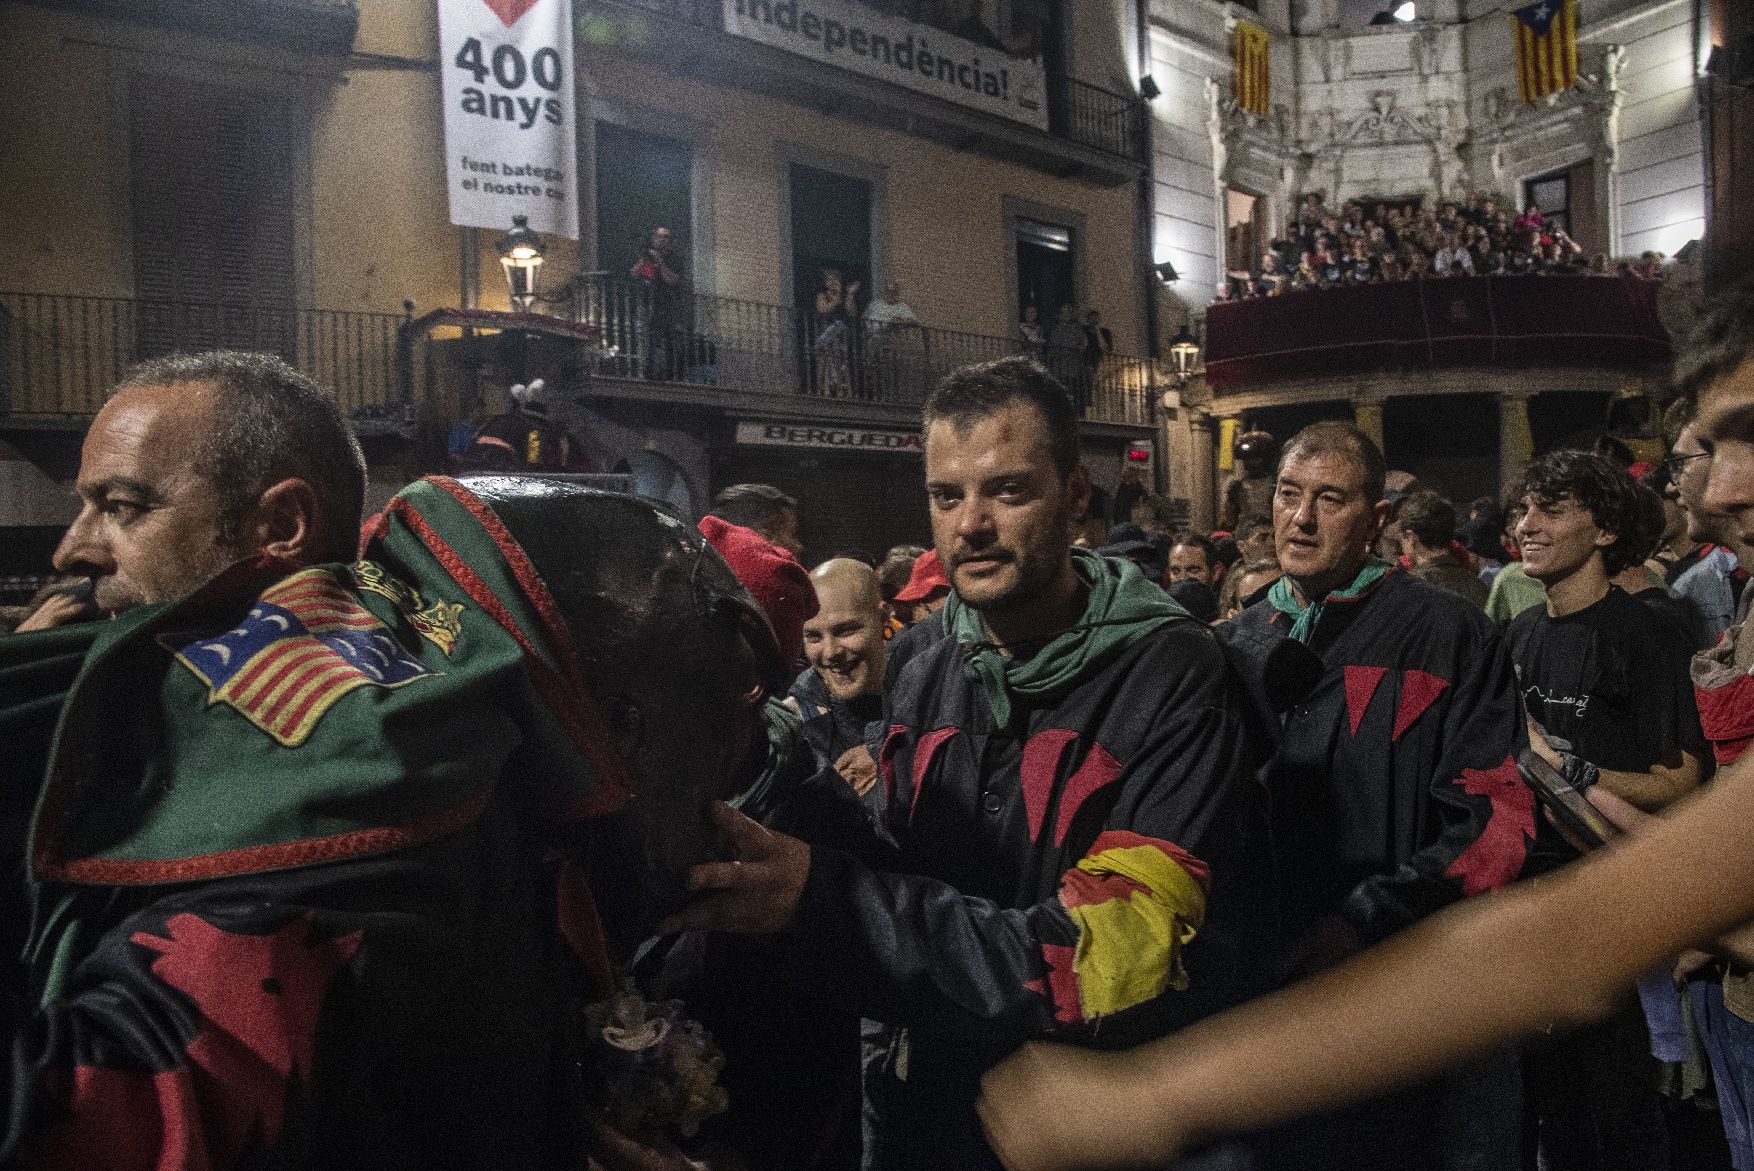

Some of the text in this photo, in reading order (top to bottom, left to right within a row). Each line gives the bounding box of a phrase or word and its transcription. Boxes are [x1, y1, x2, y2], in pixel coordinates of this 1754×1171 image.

[455, 37, 563, 91] 400
[461, 87, 563, 130] anys
[462, 178, 478, 191] el
[483, 183, 541, 196] nostre
